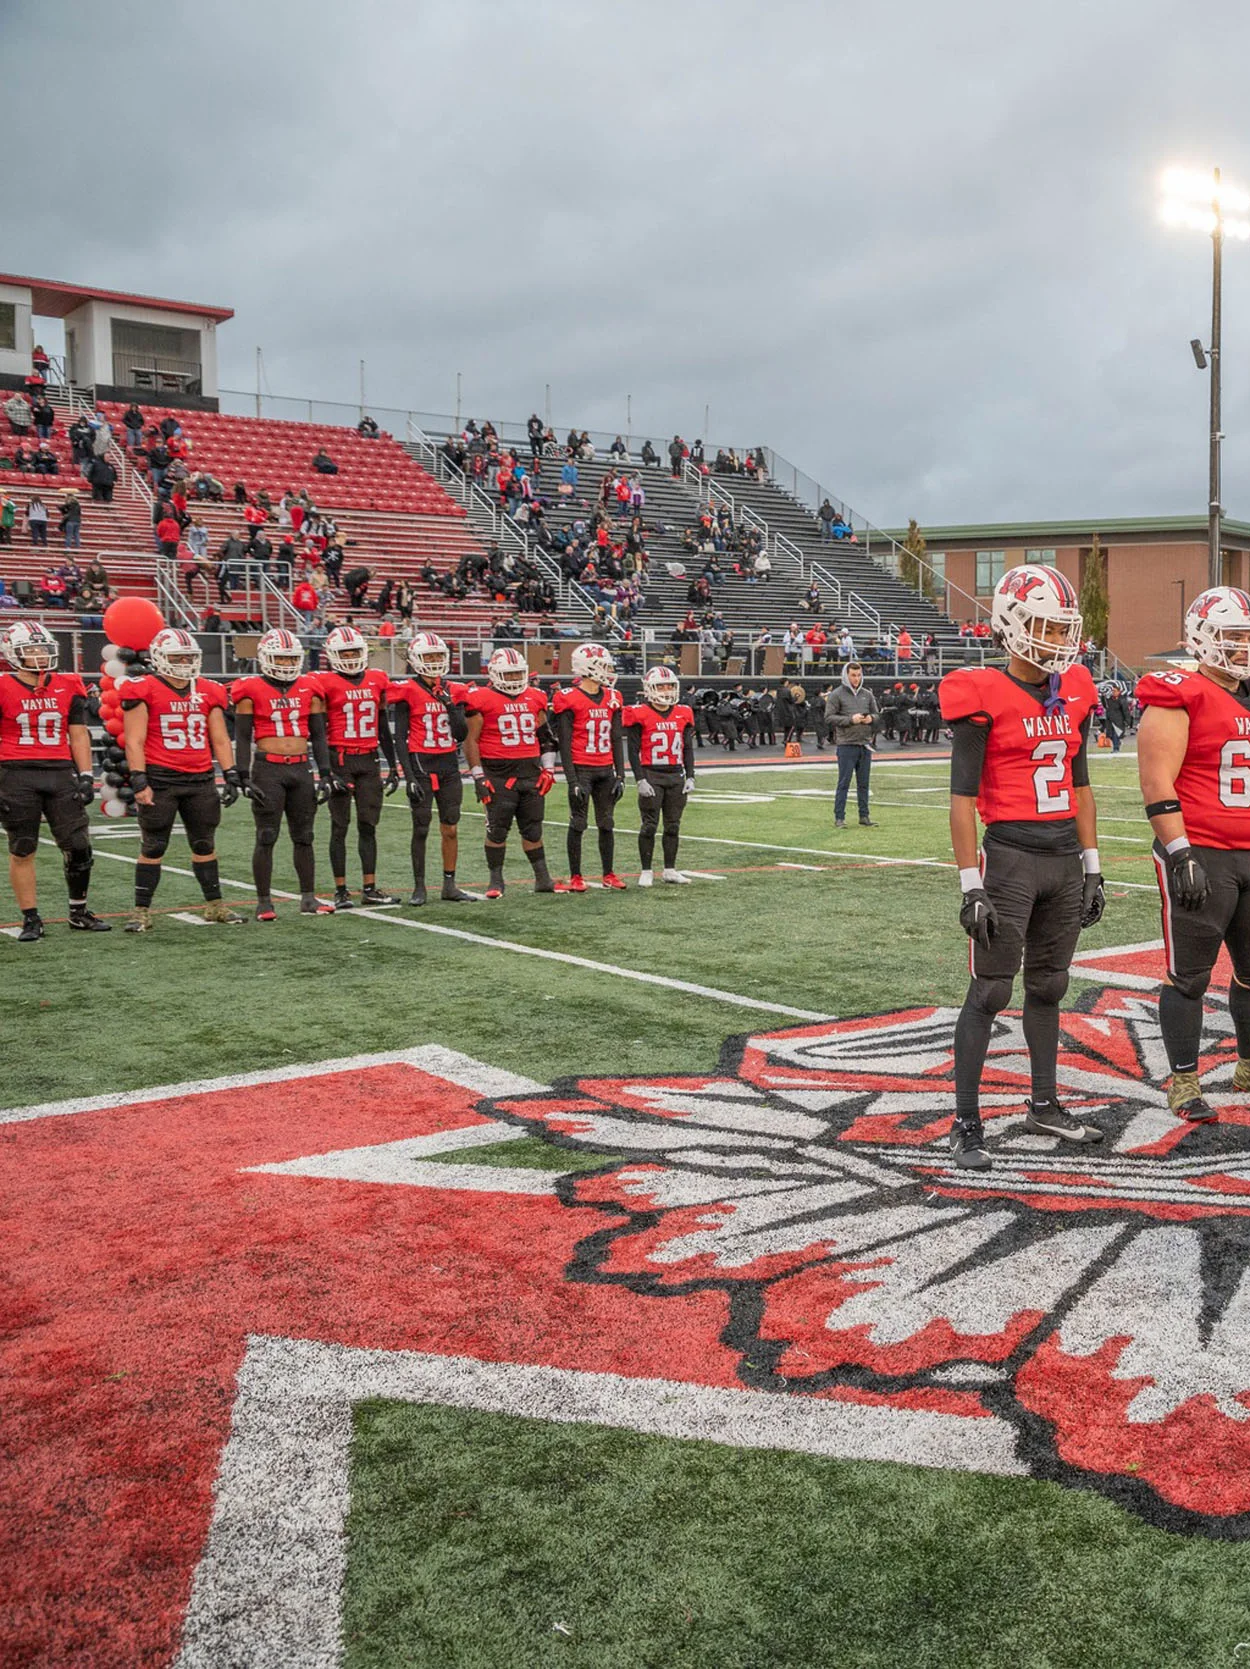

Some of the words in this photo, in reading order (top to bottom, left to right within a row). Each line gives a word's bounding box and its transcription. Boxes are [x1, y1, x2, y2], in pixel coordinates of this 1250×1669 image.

[21, 697, 59, 711] WAYNE
[169, 701, 201, 712] WAYNE
[269, 697, 302, 710] WAYNE
[345, 689, 373, 700] WAYNE
[504, 702, 529, 713] WAYNE
[15, 711, 63, 746] 10
[159, 713, 207, 750] 50
[270, 709, 301, 737] 11
[342, 700, 377, 739] 12
[497, 712, 536, 746] 99
[656, 721, 678, 731] WAYNE
[1023, 714, 1072, 738] WAYNE
[585, 719, 612, 753] 18
[650, 731, 683, 765] 24
[1031, 740, 1071, 814] 2
